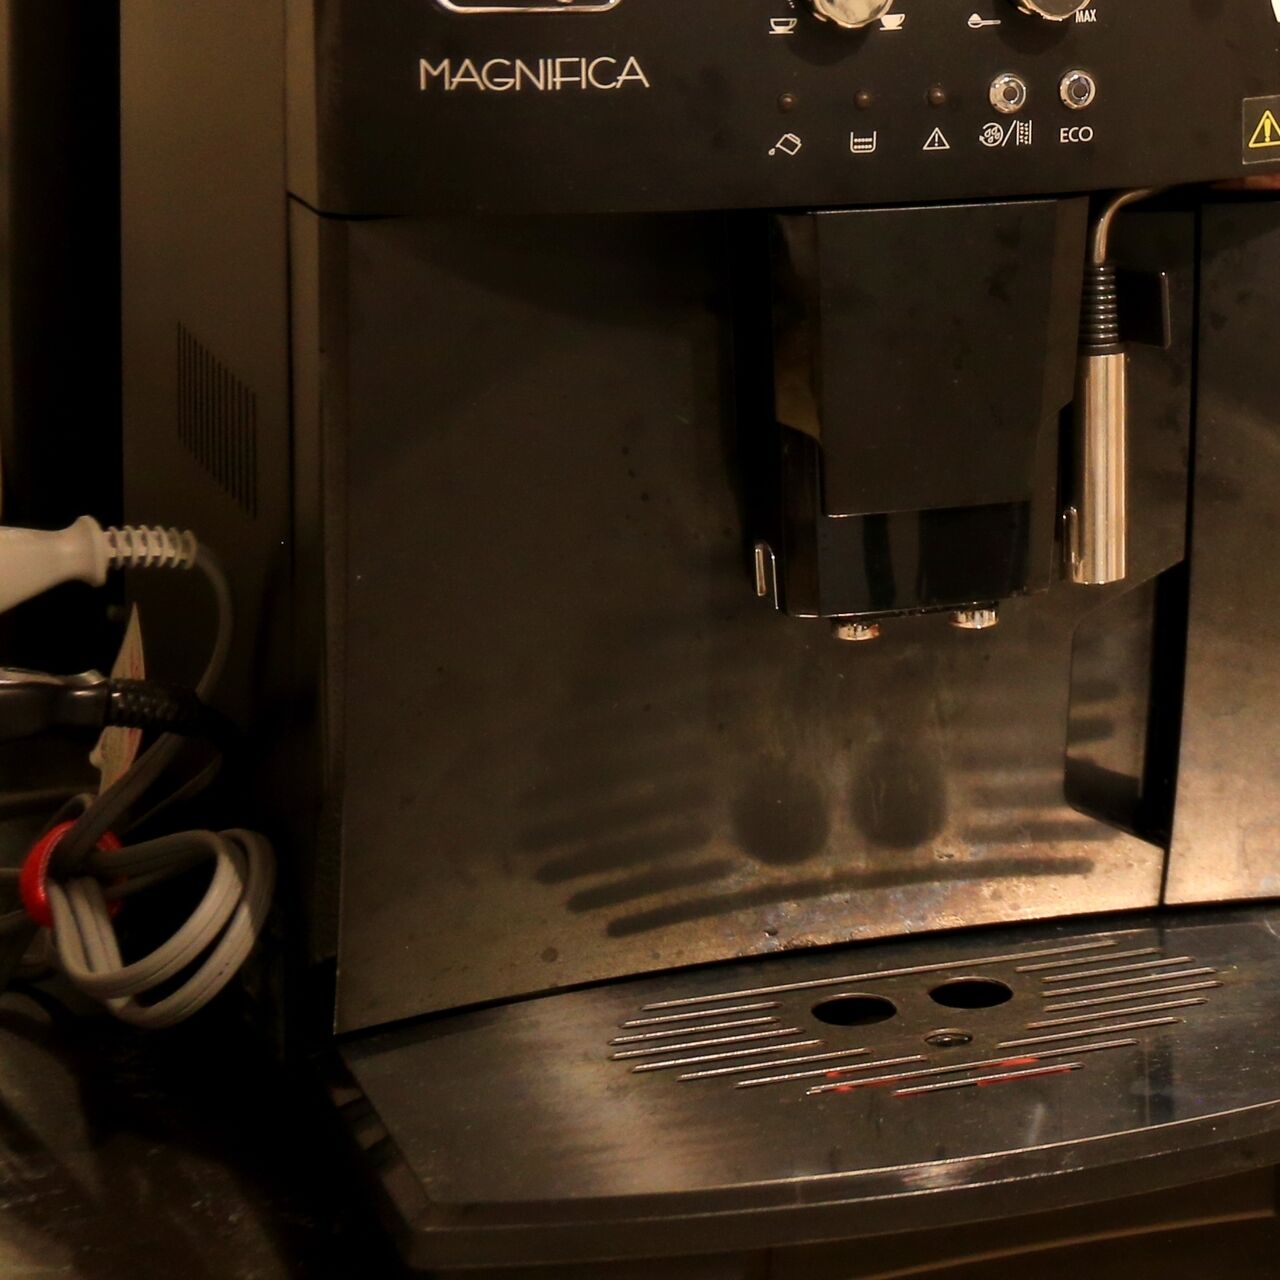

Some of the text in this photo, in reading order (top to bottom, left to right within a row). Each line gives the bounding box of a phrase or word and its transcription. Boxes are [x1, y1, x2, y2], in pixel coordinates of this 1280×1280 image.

[1075, 9, 1097, 23] MAX
[418, 56, 650, 92] MAGNIFICA
[1060, 126, 1094, 144] ECO
